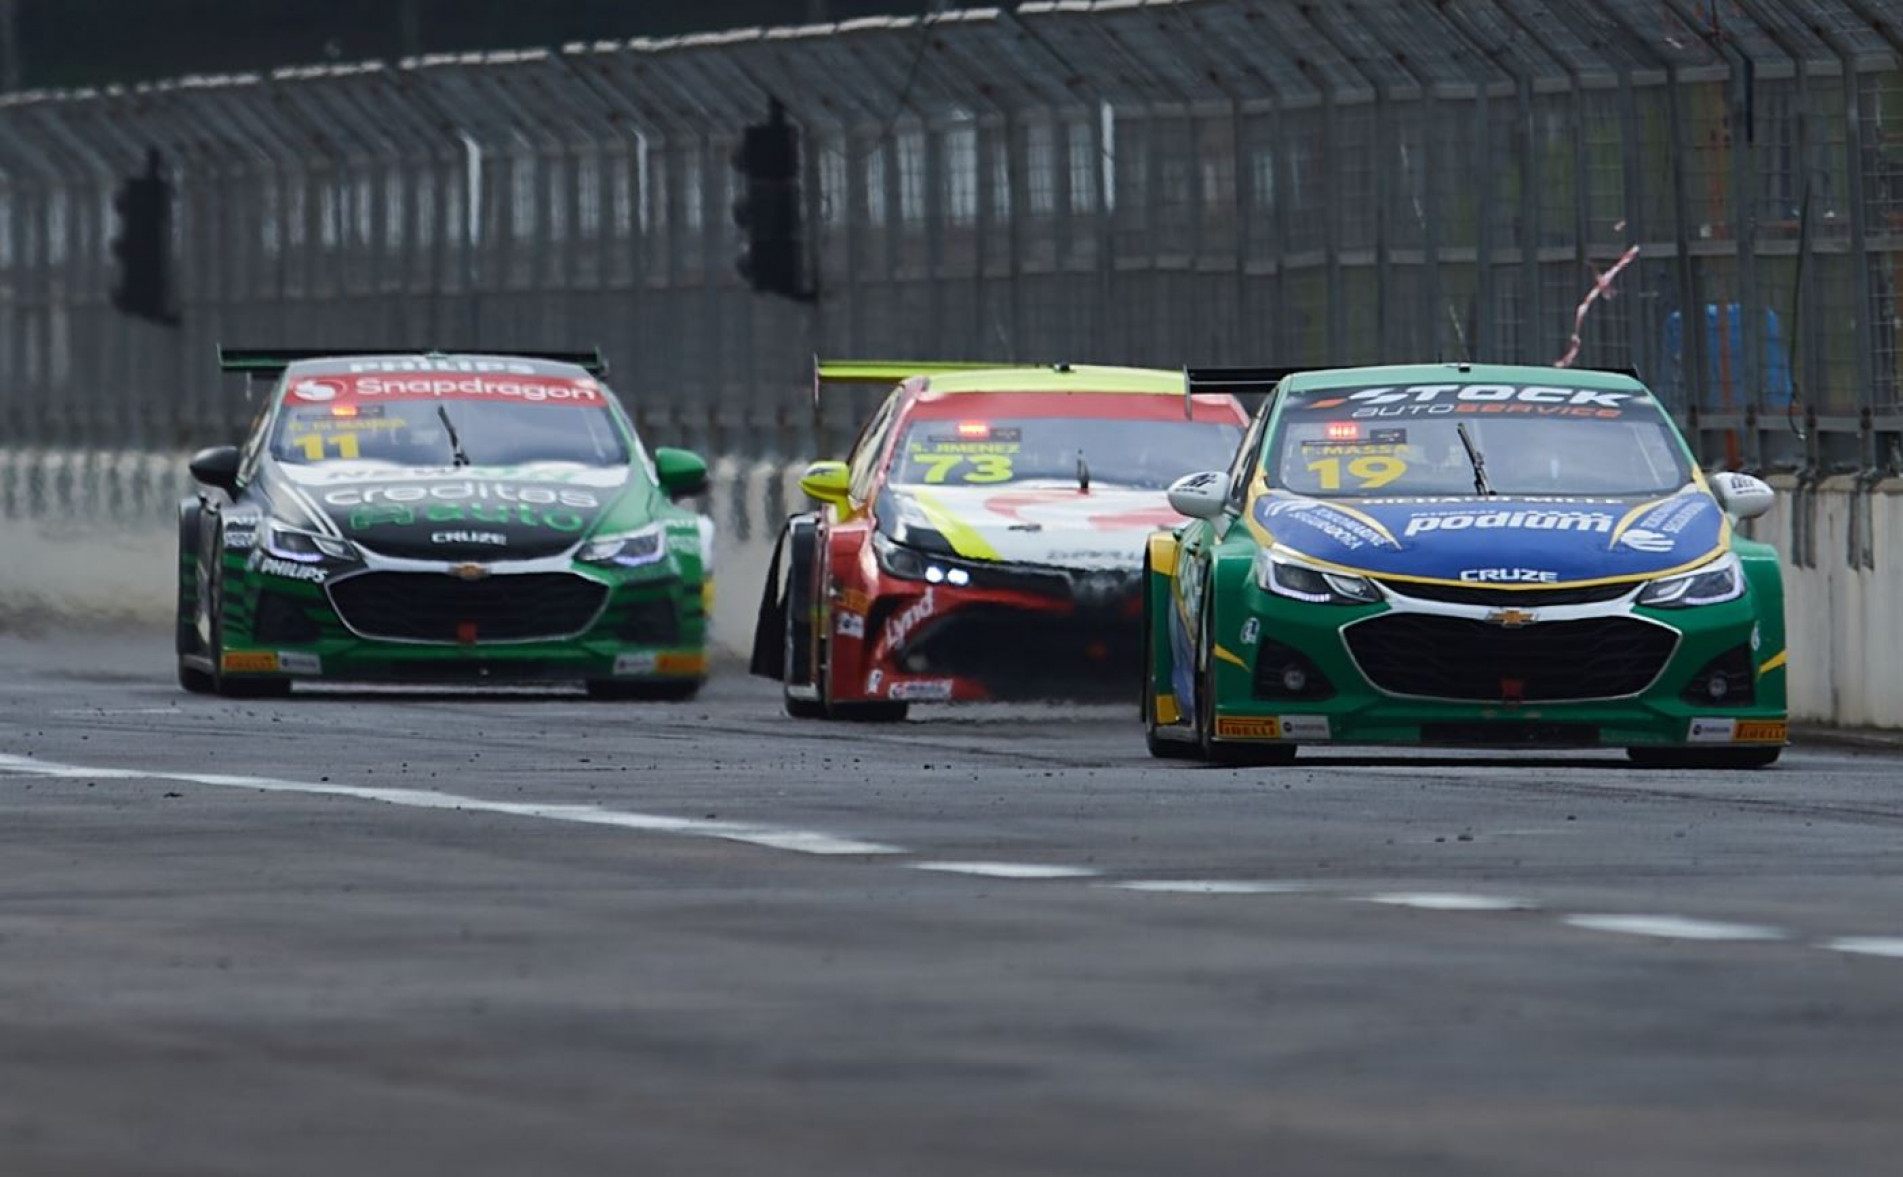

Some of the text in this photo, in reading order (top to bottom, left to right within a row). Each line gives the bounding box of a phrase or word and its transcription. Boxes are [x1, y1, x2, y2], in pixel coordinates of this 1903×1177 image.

[355, 377, 596, 401] Snapdragon
[1349, 385, 1632, 407] STOCK
[292, 433, 358, 460] 11
[912, 454, 1014, 483] 73
[1307, 456, 1407, 489] 19
[1404, 511, 1613, 537] podium
[431, 531, 506, 545] CRUZE
[261, 558, 327, 583] PHILIPS
[1460, 568, 1557, 583] CRUZE
